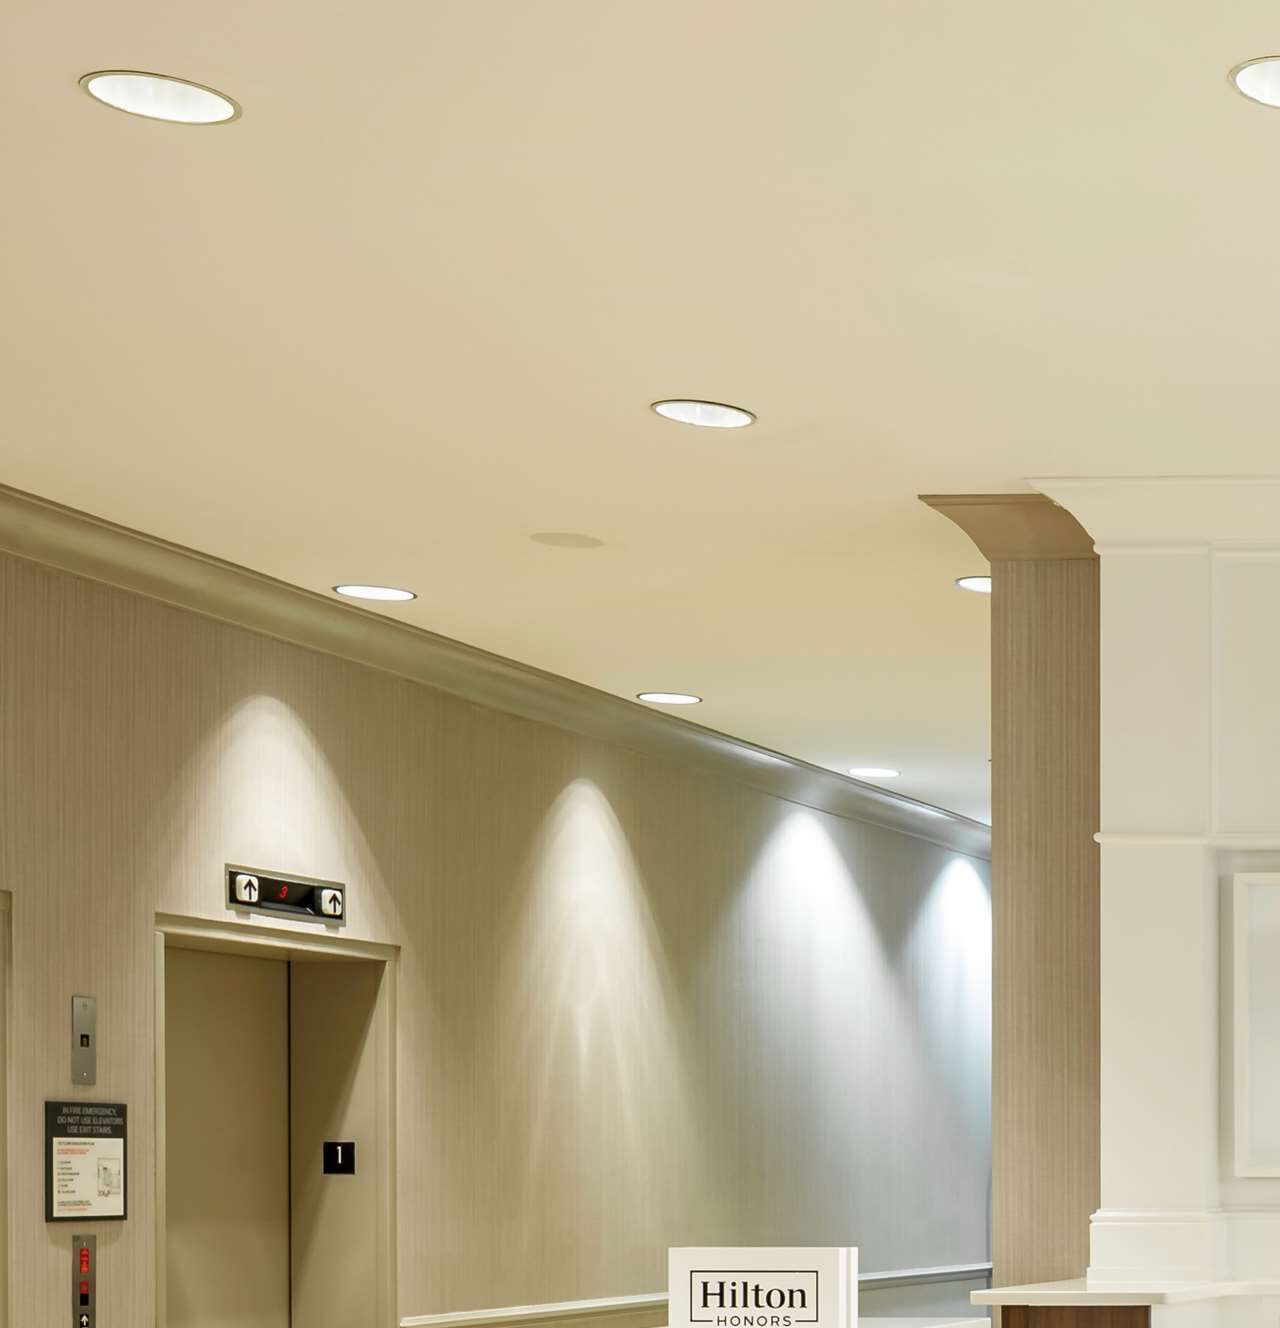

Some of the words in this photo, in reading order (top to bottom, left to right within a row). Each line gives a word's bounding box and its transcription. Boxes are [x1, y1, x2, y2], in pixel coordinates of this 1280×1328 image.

[336, 1146, 342, 1164] 1
[700, 1280, 808, 1309] Hilton
[716, 1316, 792, 1327] HONORS
